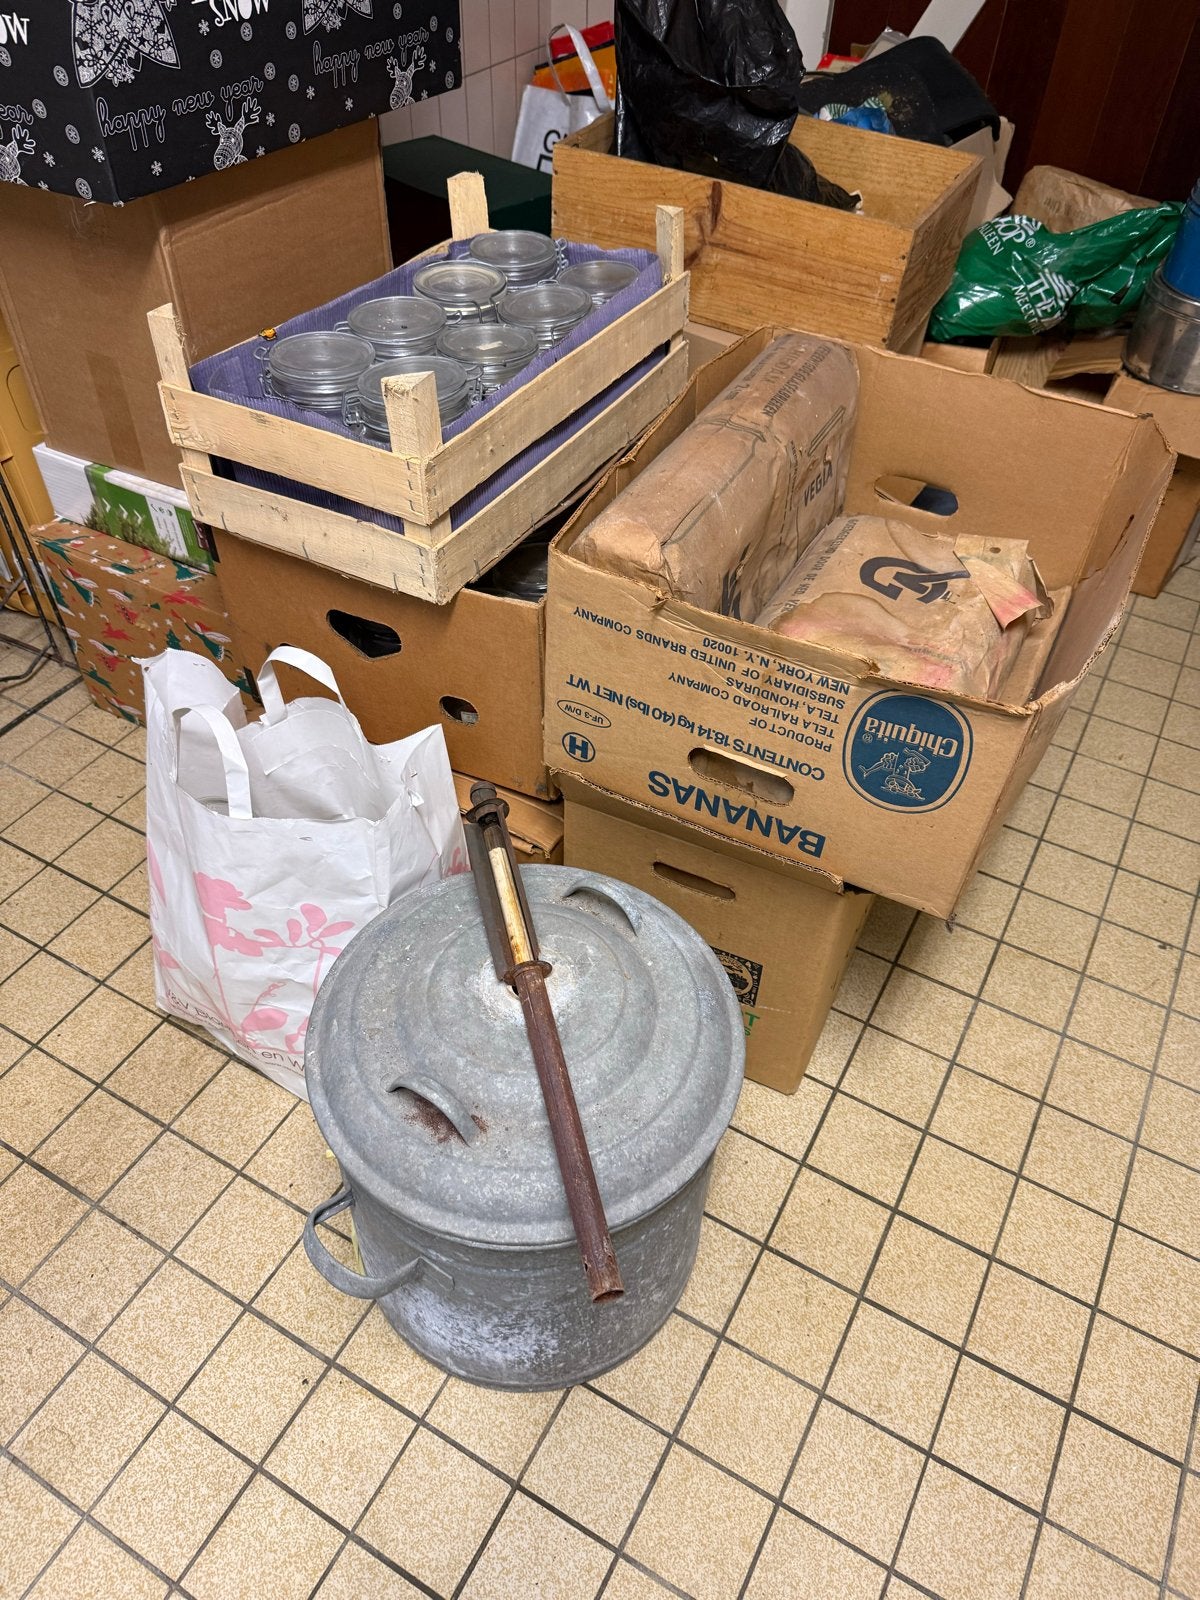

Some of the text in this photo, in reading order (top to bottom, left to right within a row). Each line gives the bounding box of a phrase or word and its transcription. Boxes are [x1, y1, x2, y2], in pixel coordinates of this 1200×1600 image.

[313, 27, 429, 89] happy new year
[96, 75, 264, 151] happy new year
[804, 460, 833, 507] VEGLA
[573, 606, 847, 710] SUBSIDIARY OF UNITED BRANDS COMPANY
[702, 637, 851, 696] NEW YORK, N.Y. 10020
[564, 704, 604, 725] UF-3 D/W
[566, 673, 826, 782] CONTENTS 18.14 kg (40 lbs) NET WT
[668, 672, 835, 739] TELA RAILROAD COMPANY
[726, 676, 840, 724] TELA, HONDURAS
[568, 734, 589, 760] H
[749, 716, 833, 753] PRODUCT OF
[863, 716, 959, 759] Chiquita
[647, 770, 827, 859] BANANAS
